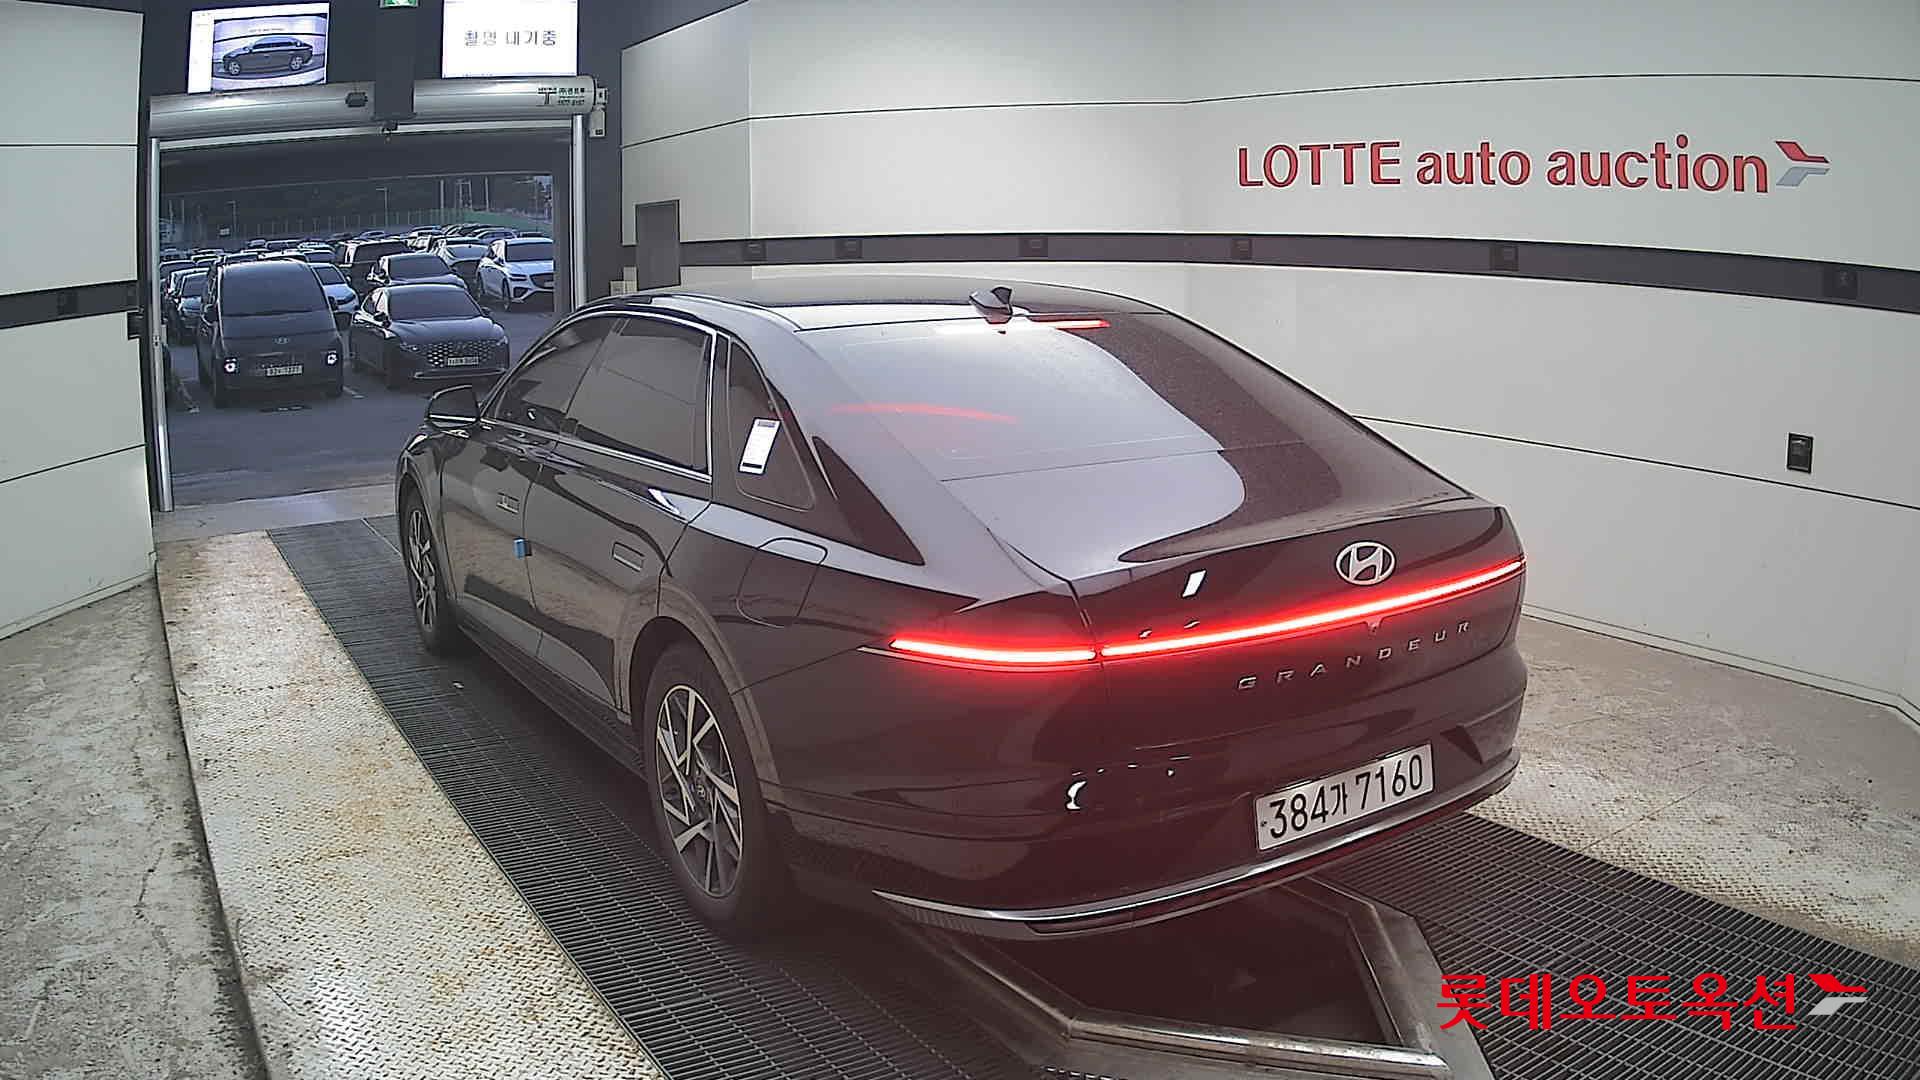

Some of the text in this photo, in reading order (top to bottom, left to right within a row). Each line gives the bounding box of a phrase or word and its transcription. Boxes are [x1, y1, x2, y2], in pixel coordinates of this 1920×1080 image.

[1238, 134, 1768, 194] LOTTE auto auction
[1238, 621, 1470, 689] GRANDEUR
[1269, 754, 1424, 839] 384가 7160
